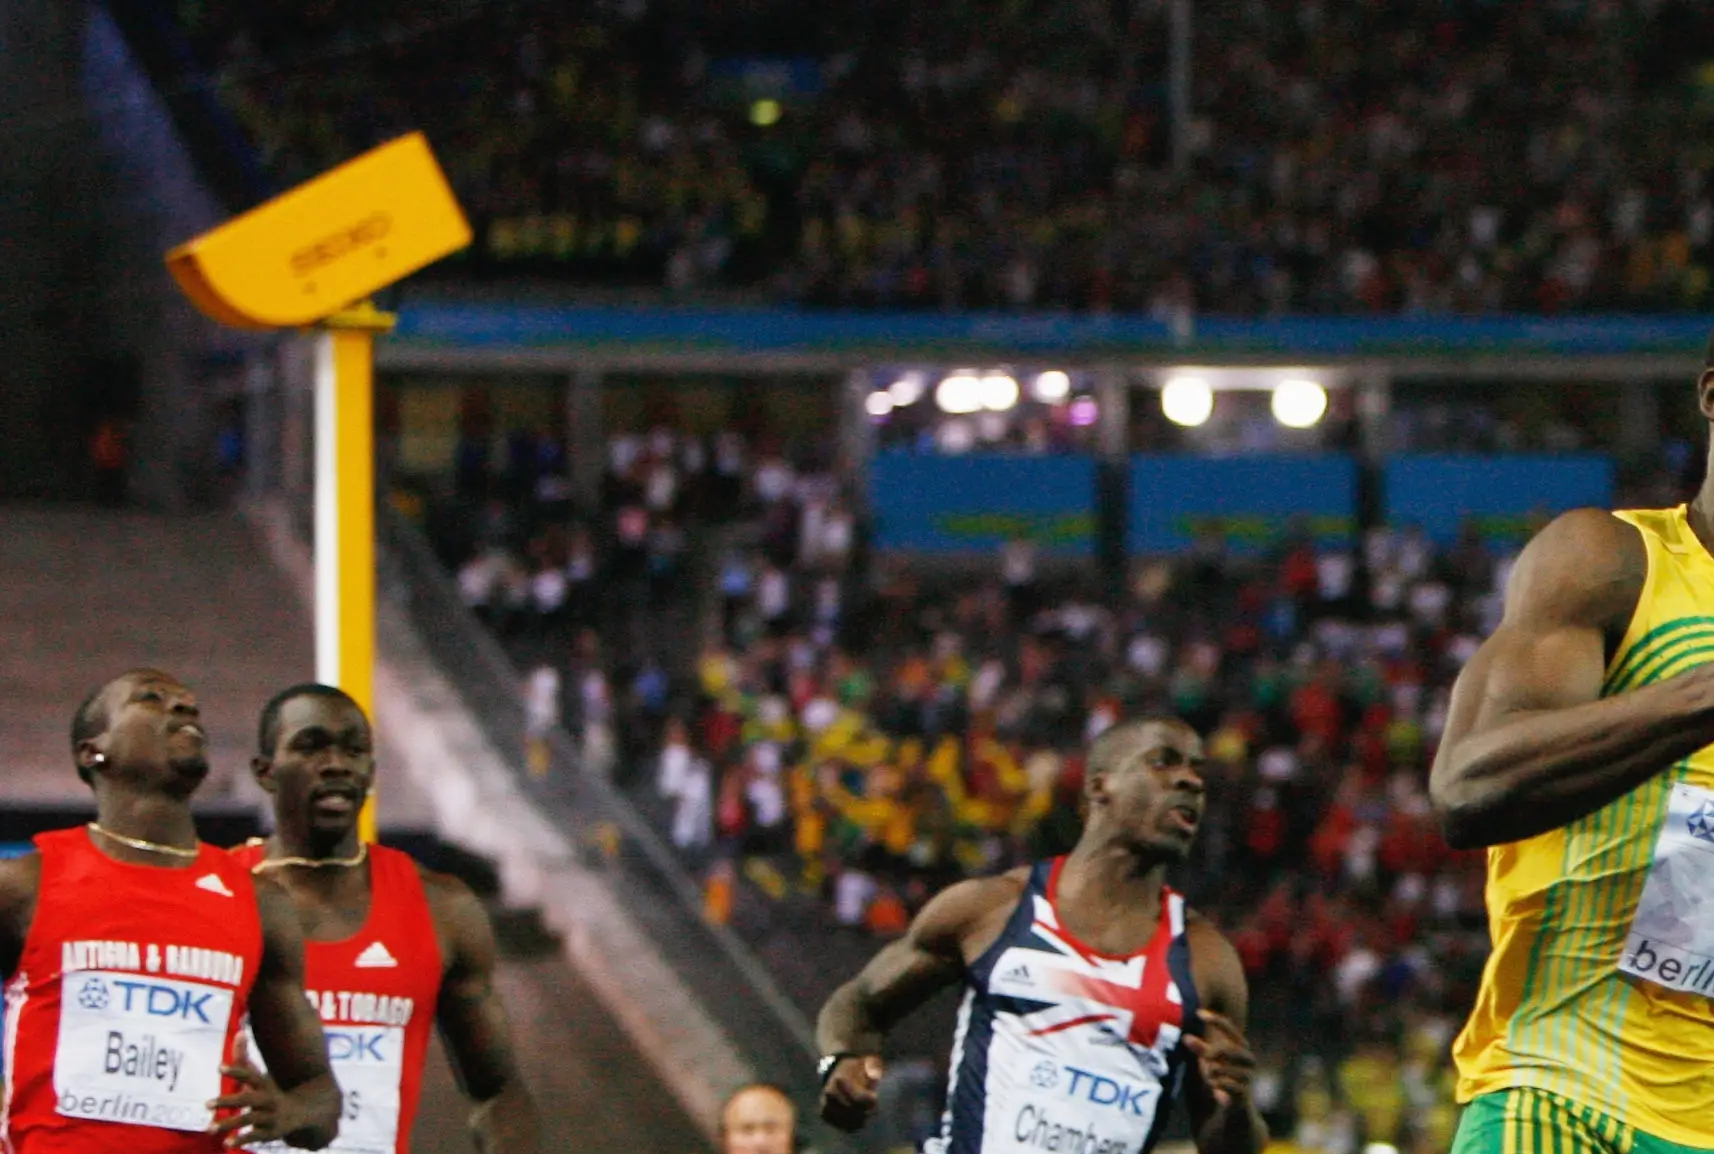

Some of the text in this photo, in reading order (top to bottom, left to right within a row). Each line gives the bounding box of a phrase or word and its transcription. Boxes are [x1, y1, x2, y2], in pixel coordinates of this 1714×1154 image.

[113, 981, 213, 1025] TDK
[104, 1031, 185, 1093] Bailey
[324, 1032, 385, 1061] DK
[61, 1089, 149, 1119] berlin
[1064, 1066, 1151, 1116] TDK
